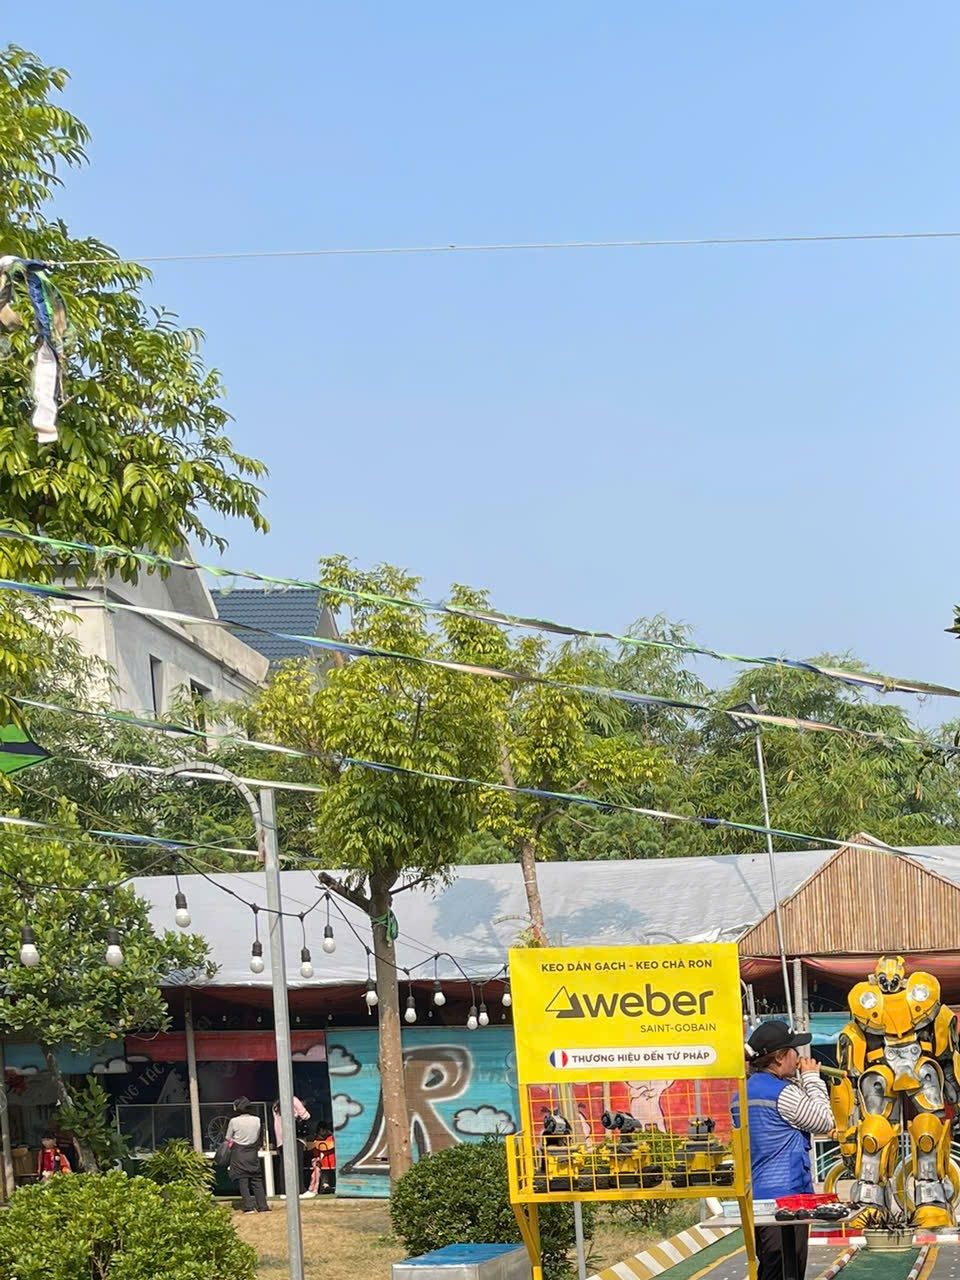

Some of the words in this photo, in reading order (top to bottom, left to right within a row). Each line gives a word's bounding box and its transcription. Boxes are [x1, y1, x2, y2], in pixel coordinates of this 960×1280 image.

[541, 963, 565, 972] KEO
[567, 961, 592, 971] DÁN
[594, 961, 626, 972] GẠCH
[636, 961, 659, 970] KEO
[688, 959, 712, 968] RON
[583, 983, 714, 1018] weber
[640, 1023, 717, 1033] SAINT-GOBAIN
[572, 1054, 615, 1063] THƯƠNG
[617, 1051, 640, 1063] HIỆU
[643, 1050, 664, 1061] ĐẾN
[683, 1050, 710, 1060] PHÁP
